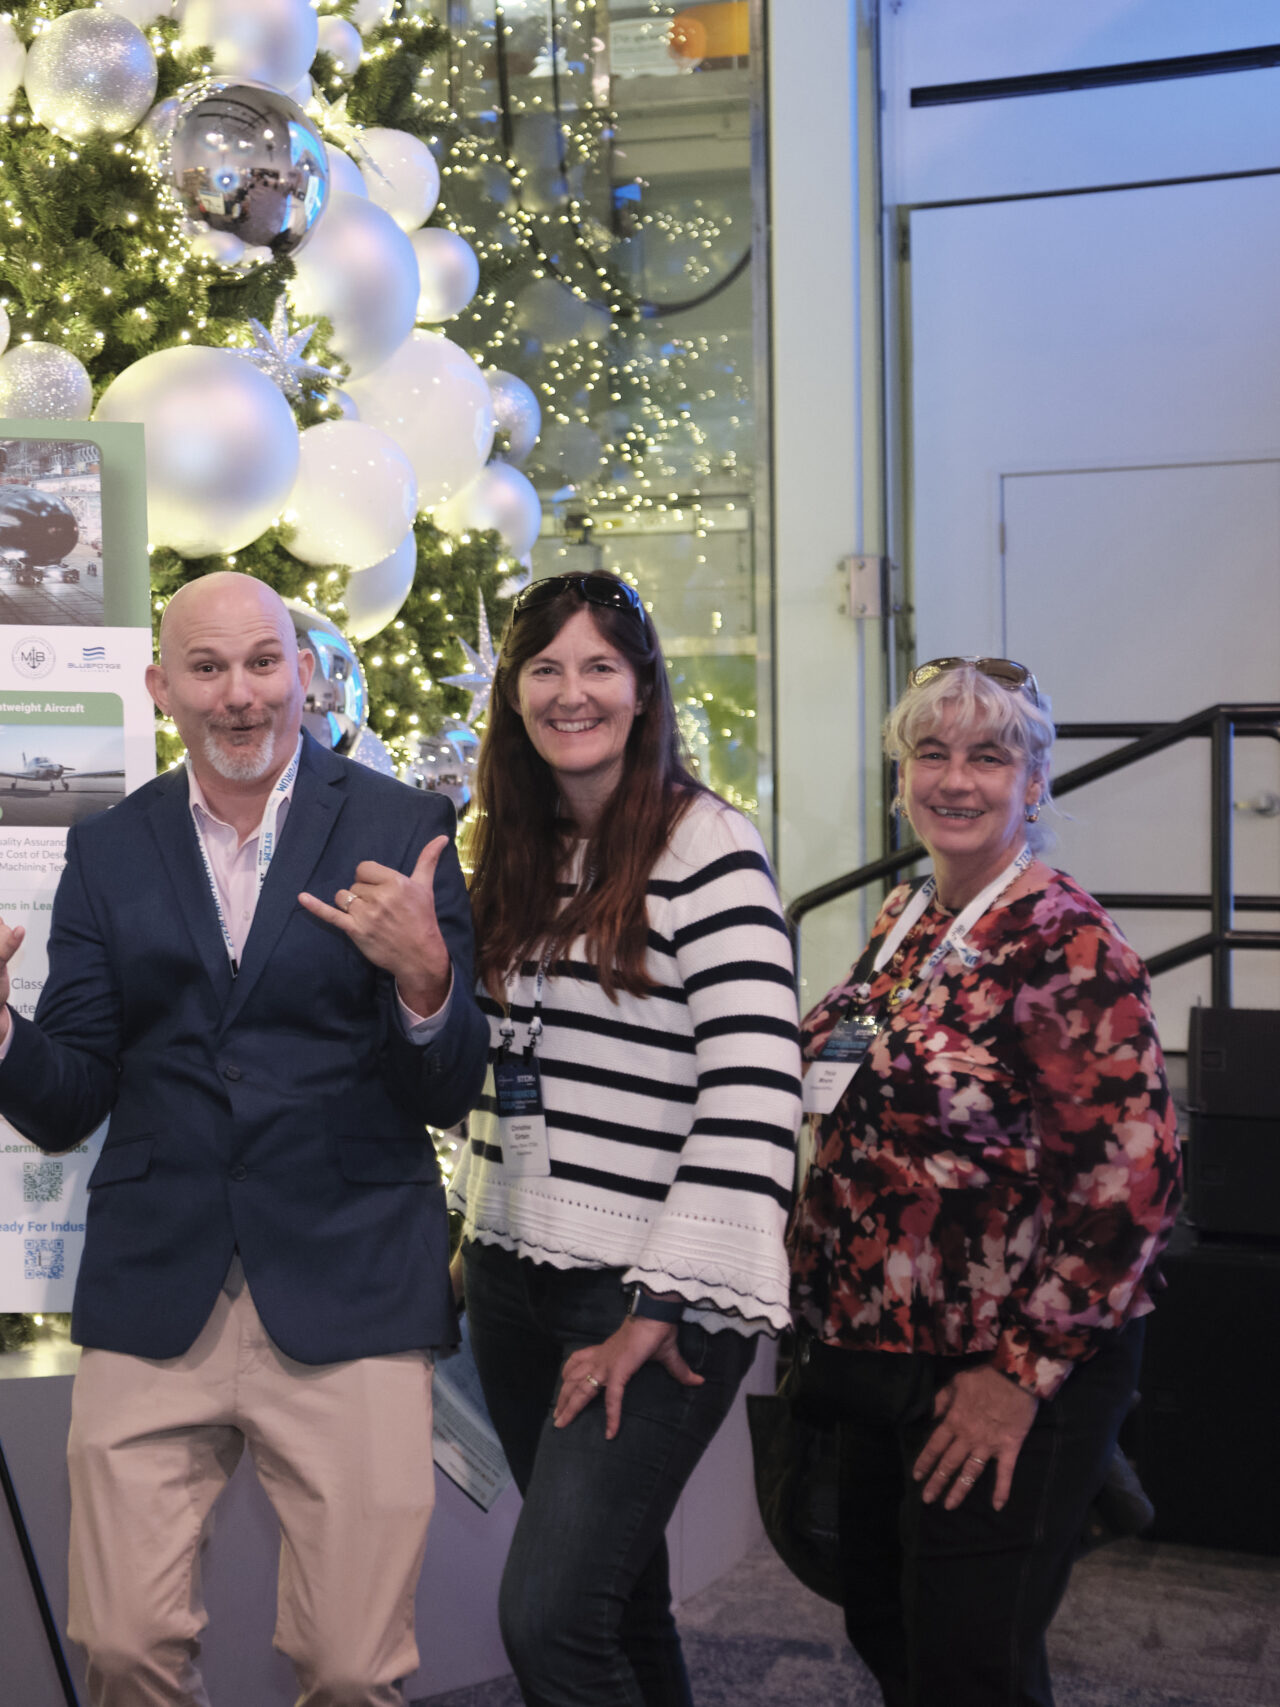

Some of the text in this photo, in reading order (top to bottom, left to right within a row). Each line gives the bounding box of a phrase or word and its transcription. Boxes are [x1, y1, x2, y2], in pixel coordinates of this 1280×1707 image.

[44, 703, 85, 713] Aircraft
[24, 837, 66, 847] Assuranc
[6, 850, 28, 859] Cost
[30, 850, 40, 859] of
[0, 862, 46, 873] Machining
[20, 901, 30, 910] in
[27, 1222, 48, 1232] For
